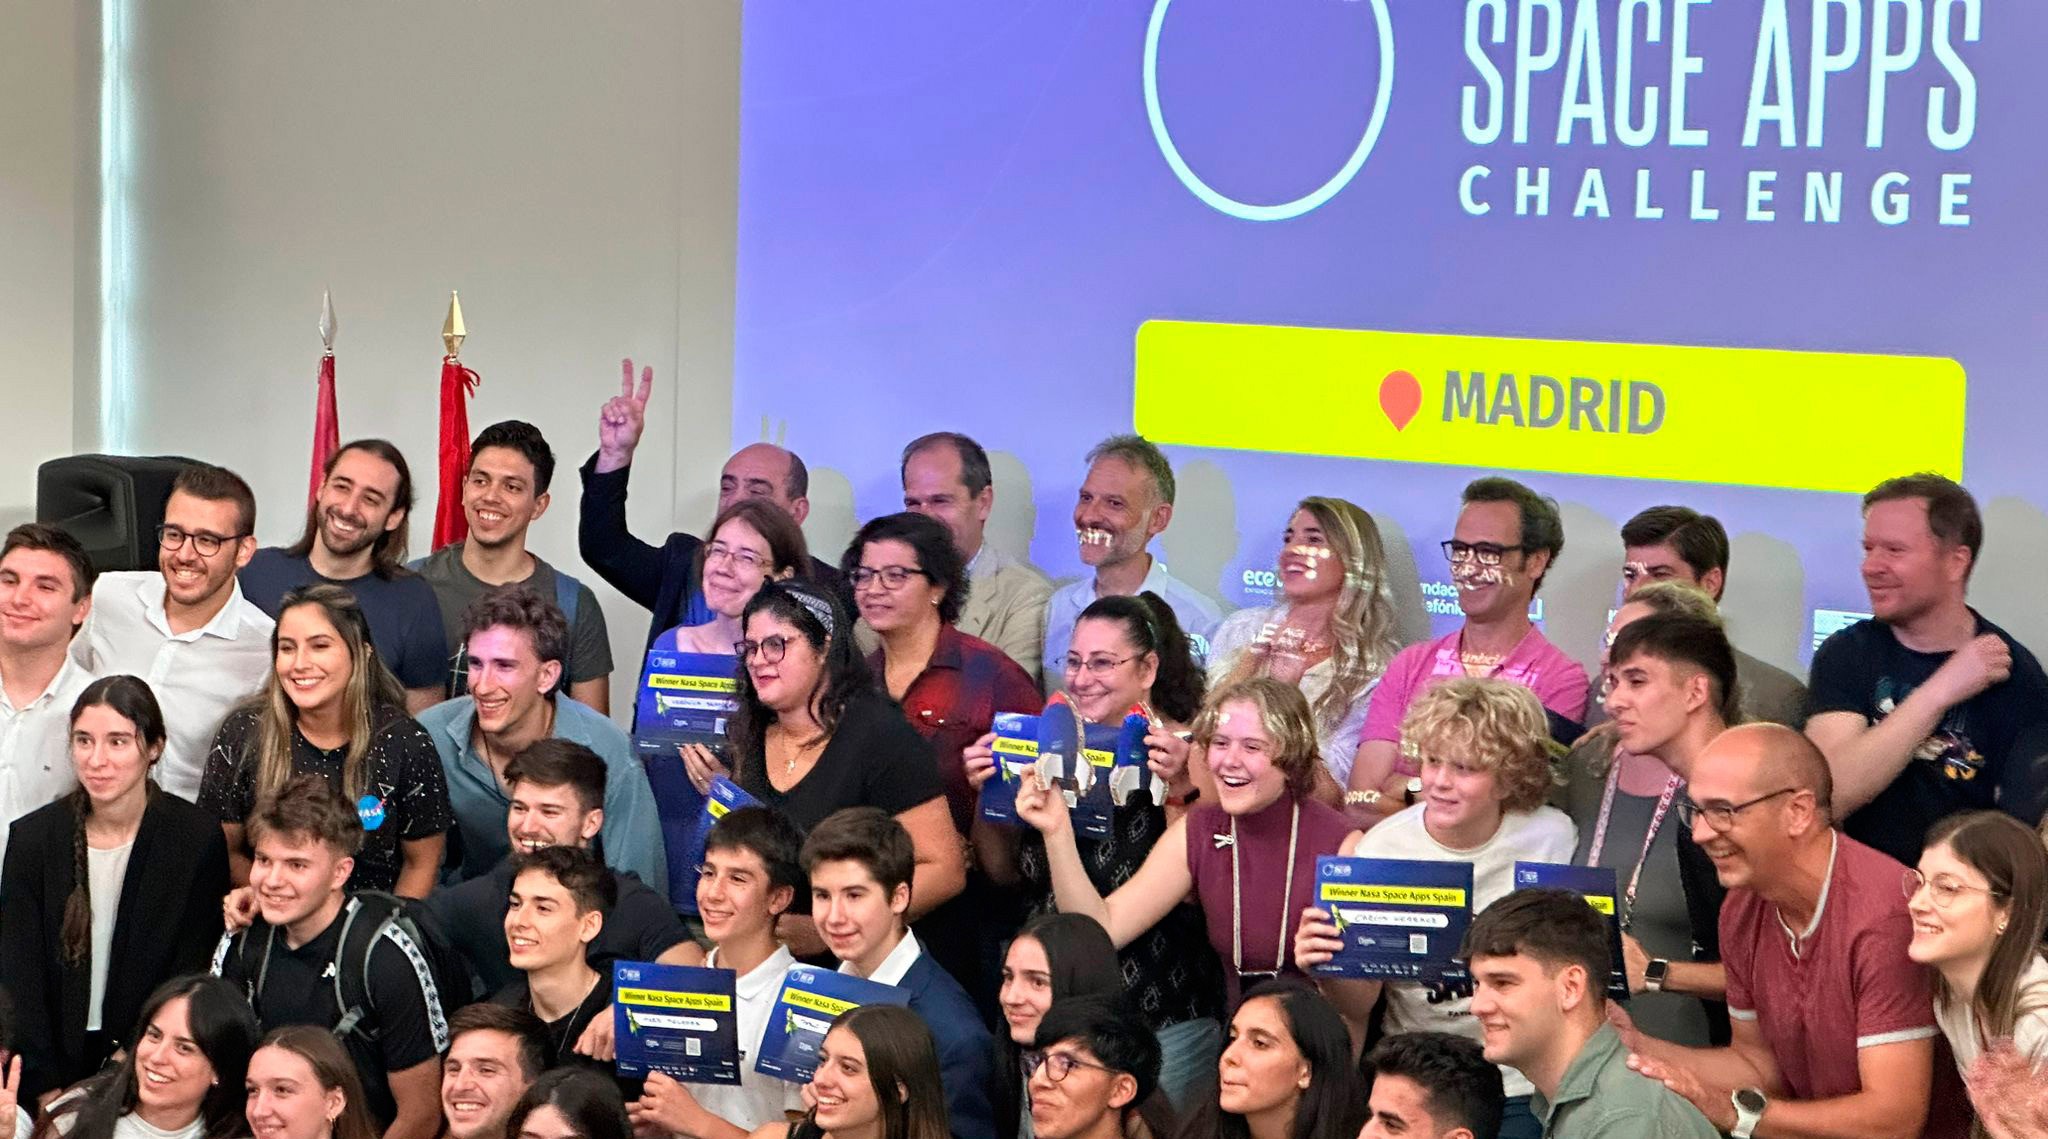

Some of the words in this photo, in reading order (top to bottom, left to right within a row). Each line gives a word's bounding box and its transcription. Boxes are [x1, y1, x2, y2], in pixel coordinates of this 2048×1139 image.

[1461, 0, 1710, 146] SPACE
[1742, 0, 1982, 152] APPS
[1459, 165, 1973, 227] CHALLENGE
[1441, 370, 1667, 436] MADRID
[655, 677, 679, 686] Winner
[681, 678, 697, 687] Nasa
[699, 680, 718, 689] Space
[1000, 740, 1024, 751] Winner
[1086, 752, 1106, 763] Spain
[1330, 888, 1358, 896] Winner
[1360, 889, 1381, 898] Nasa
[1383, 890, 1408, 900] Space
[1409, 891, 1431, 902] Apps
[1433, 893, 1457, 904] Spain
[624, 992, 646, 1000] Winner
[664, 995, 683, 1004] Space
[684, 997, 703, 1005] Apps
[704, 998, 724, 1007] Spain
[790, 992, 813, 1004] Winner
[814, 998, 830, 1010] Nasa
